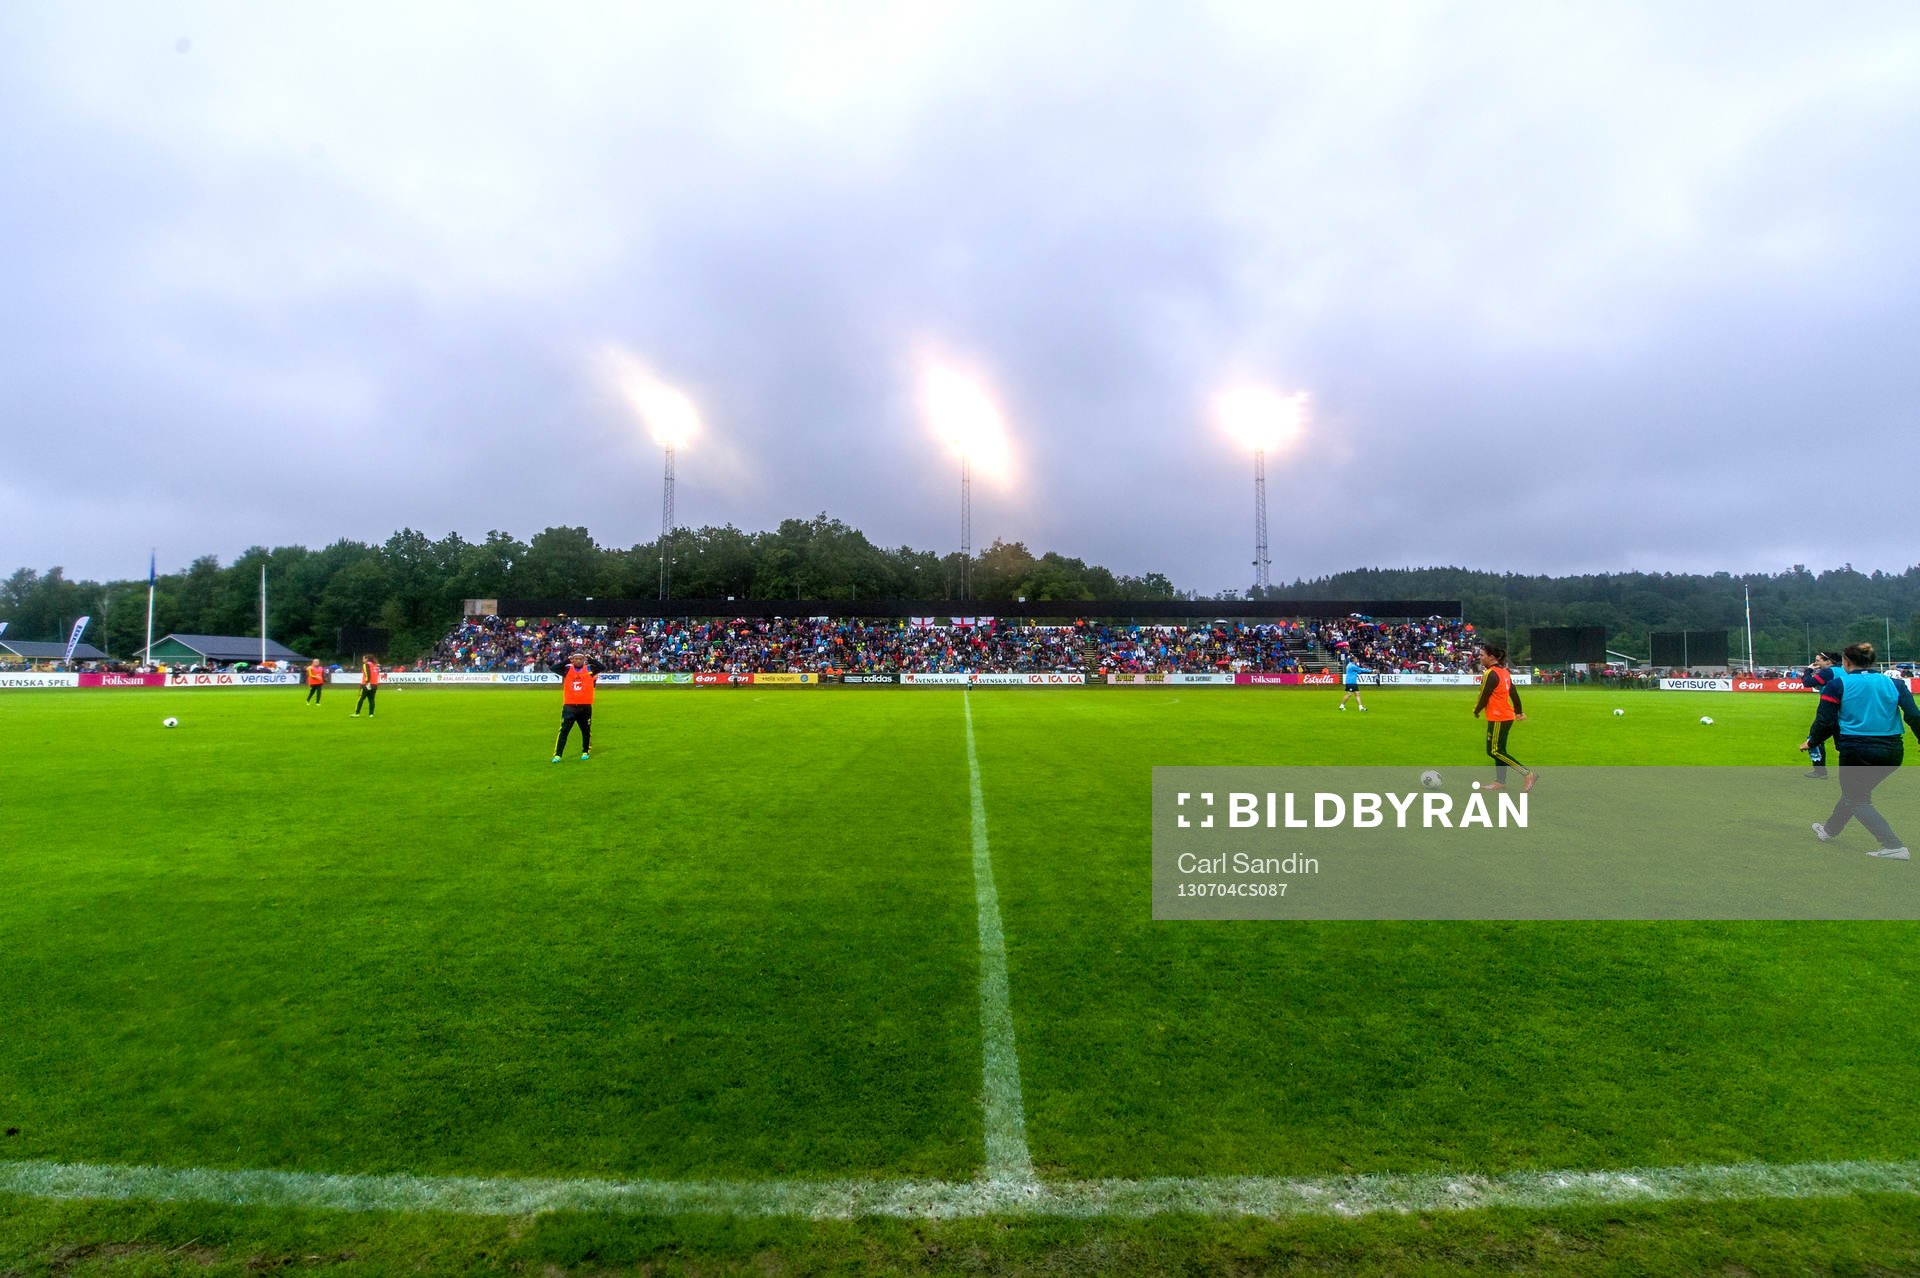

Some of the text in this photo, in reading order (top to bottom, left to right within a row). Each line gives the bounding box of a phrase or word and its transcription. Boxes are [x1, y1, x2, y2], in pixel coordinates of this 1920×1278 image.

[102, 675, 144, 685] Folksam
[171, 675, 233, 685] ICA ICA ICA
[241, 674, 287, 683] verisure
[502, 674, 548, 682] verisure
[863, 674, 893, 683] adidas
[1028, 675, 1082, 683] ICA ICA ICA
[1251, 675, 1281, 684] Folksam
[1303, 673, 1334, 684] Estrella
[0, 679, 71, 687] VENSKA SPEL
[1668, 680, 1717, 689] verisure
